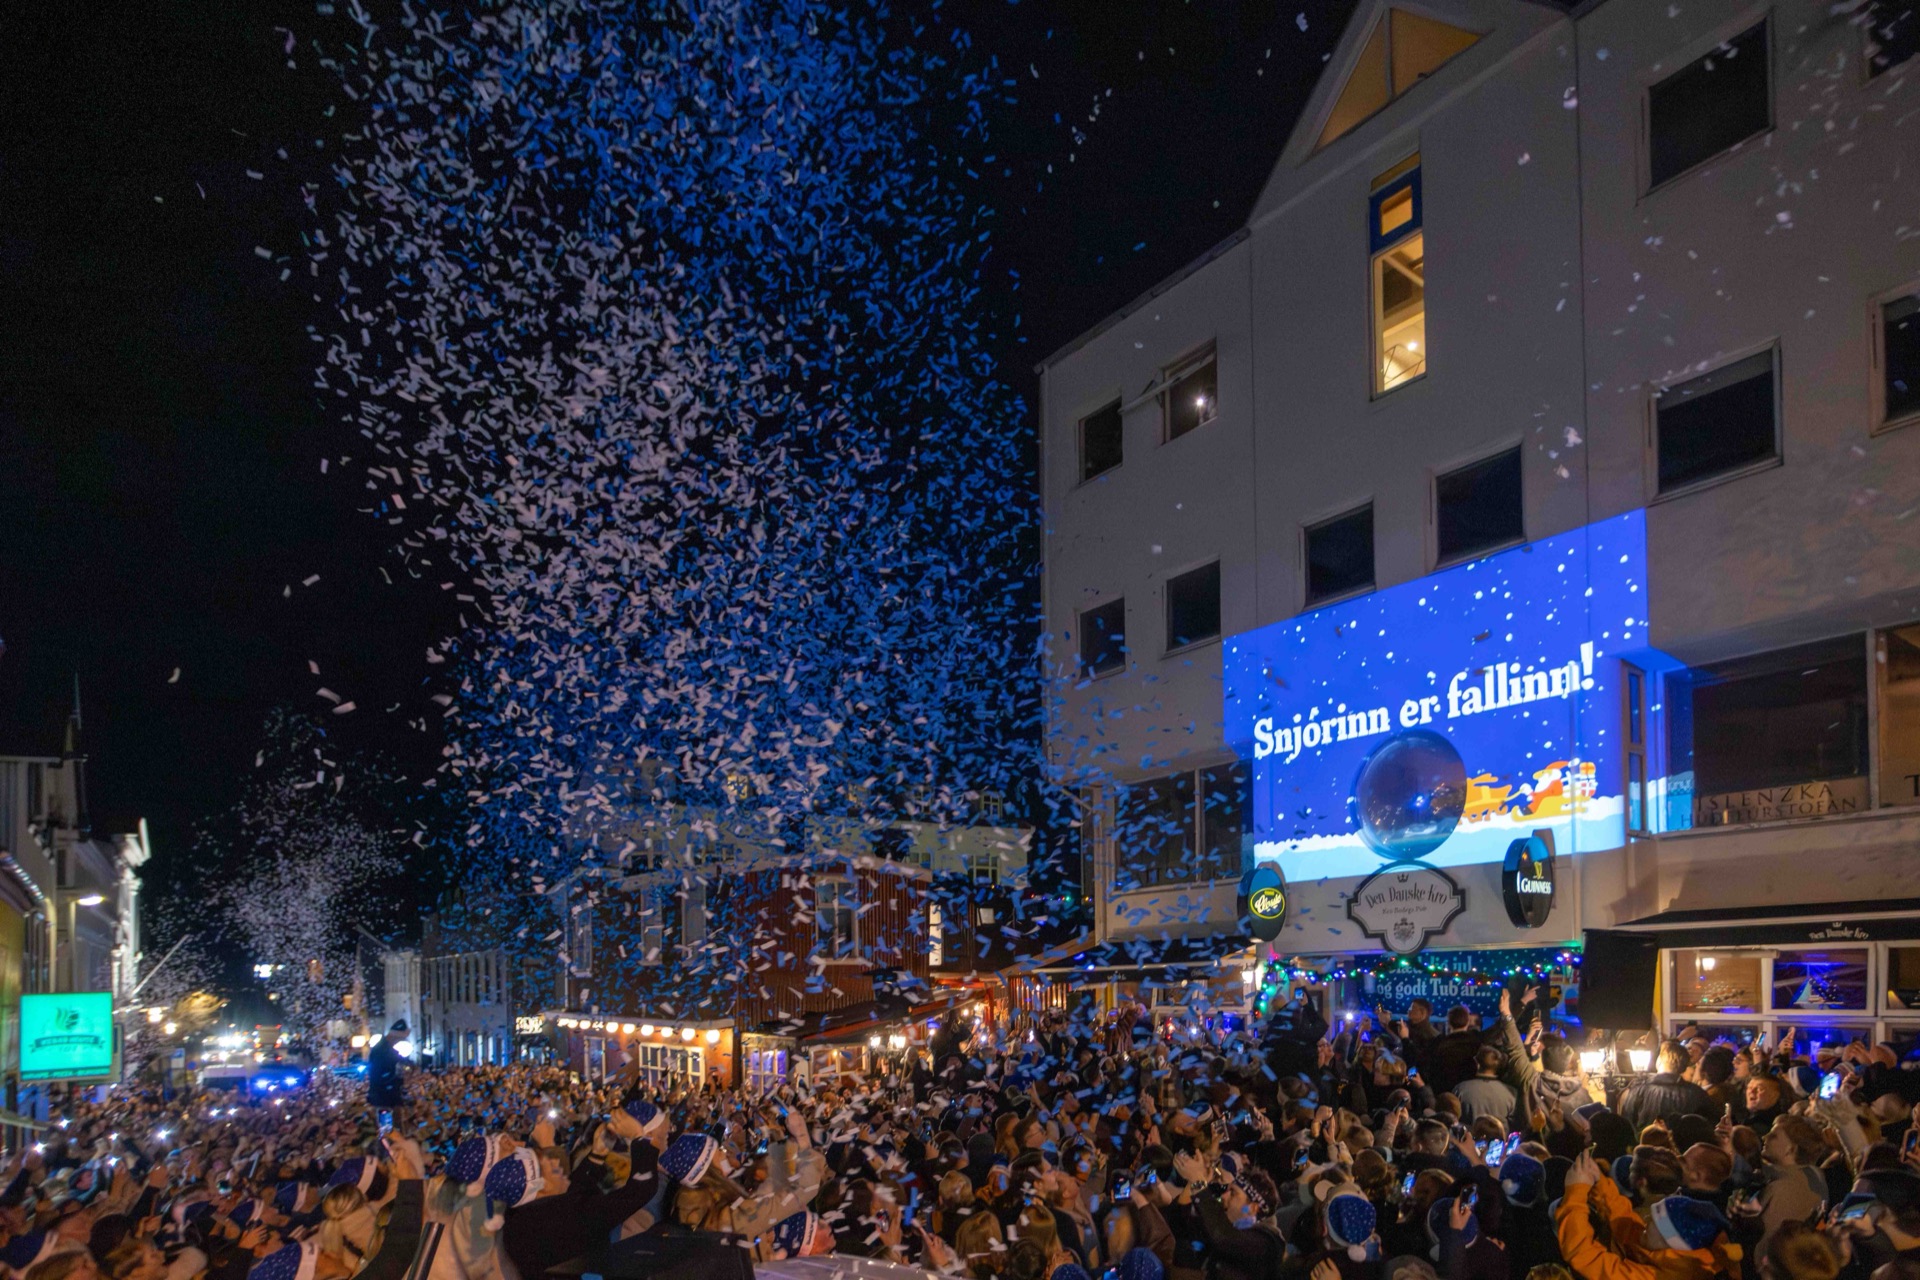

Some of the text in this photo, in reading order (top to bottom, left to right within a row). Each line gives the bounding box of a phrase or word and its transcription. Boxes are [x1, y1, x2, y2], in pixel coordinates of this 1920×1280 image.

[1253, 640, 1595, 764] Snjórinn er fallinn!
[1365, 882, 1448, 908] Den Danske Kro
[1520, 877, 1552, 895] GUINNESS
[1377, 981, 1392, 999] og
[1395, 978, 1427, 999] godt
